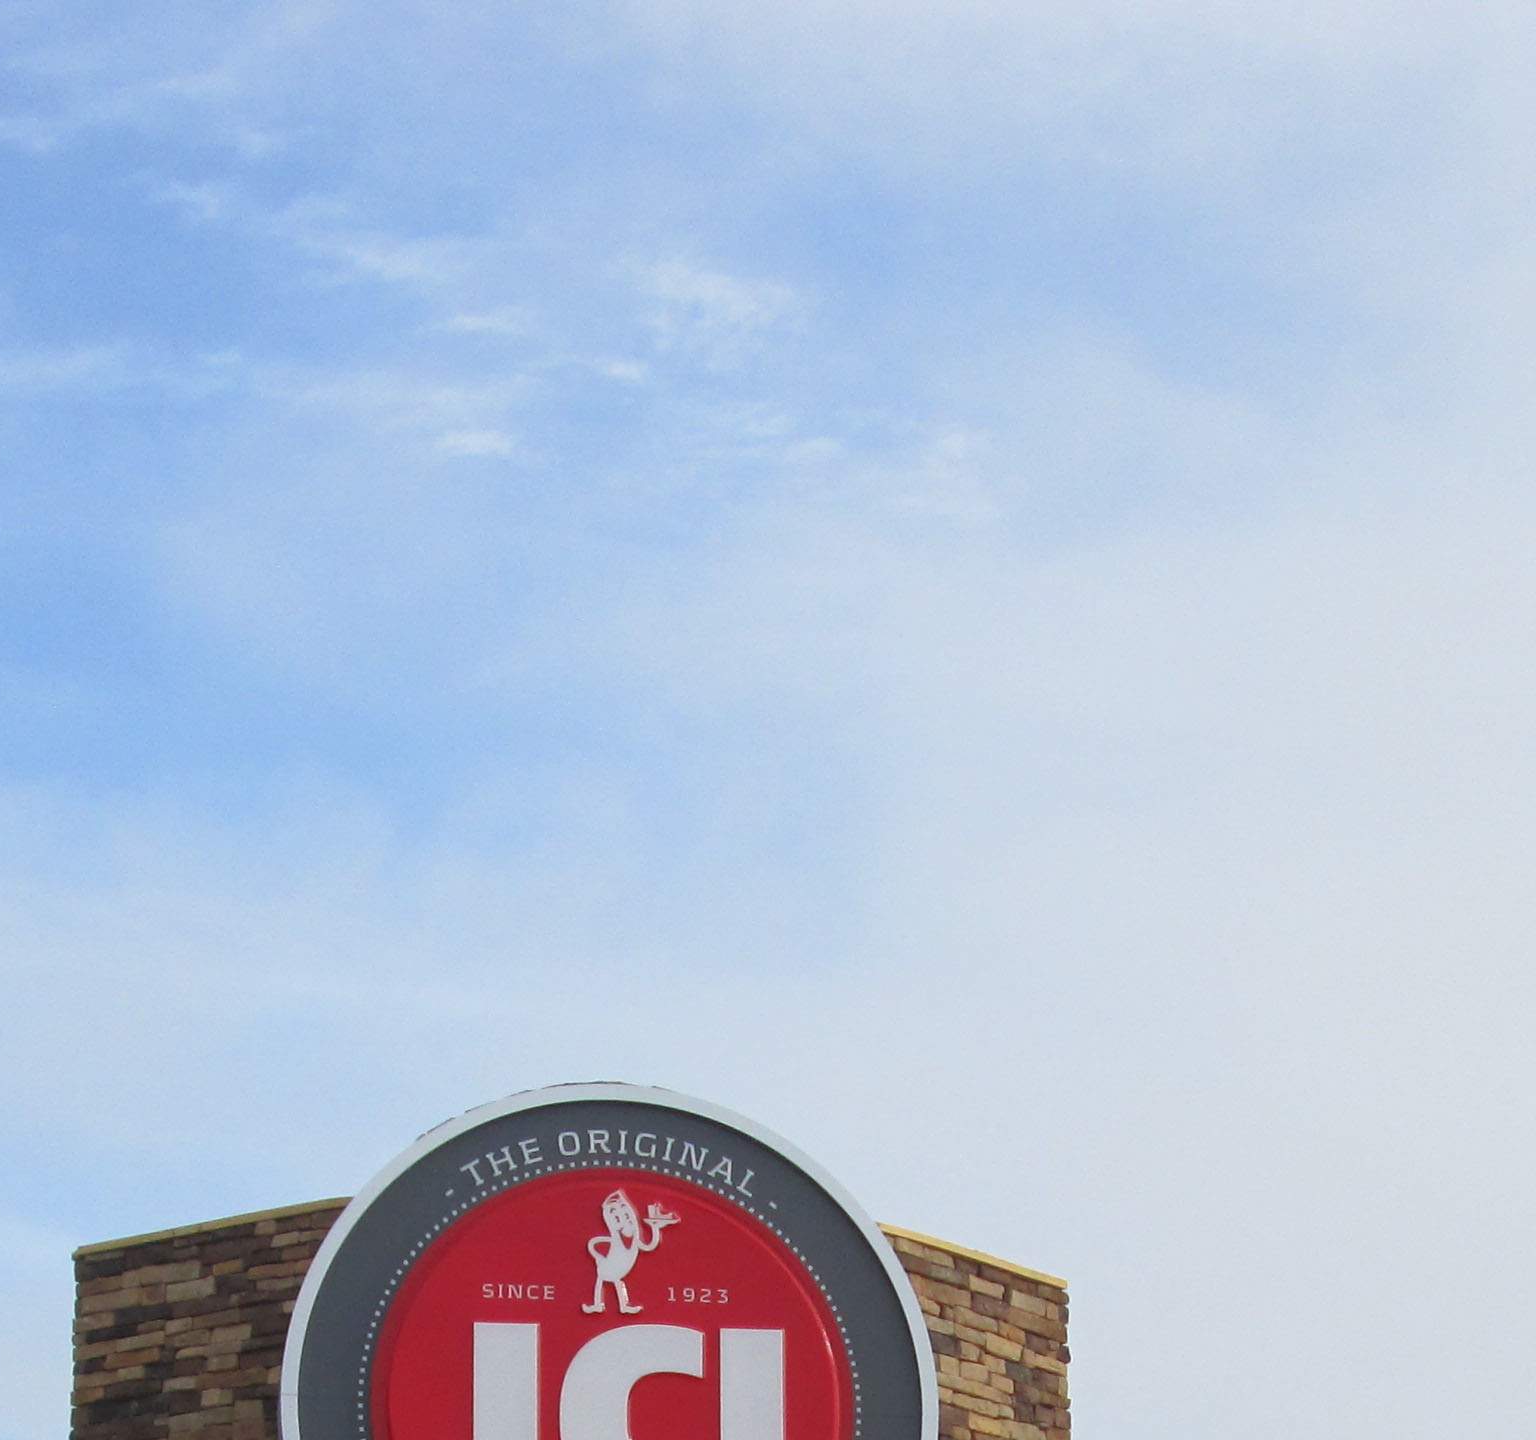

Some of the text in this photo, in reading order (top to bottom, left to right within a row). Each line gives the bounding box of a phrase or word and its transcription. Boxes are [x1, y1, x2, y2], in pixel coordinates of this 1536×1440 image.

[461, 1129, 759, 1197] THE ORIGINAL
[481, 1283, 729, 1304] SINCE 1923
